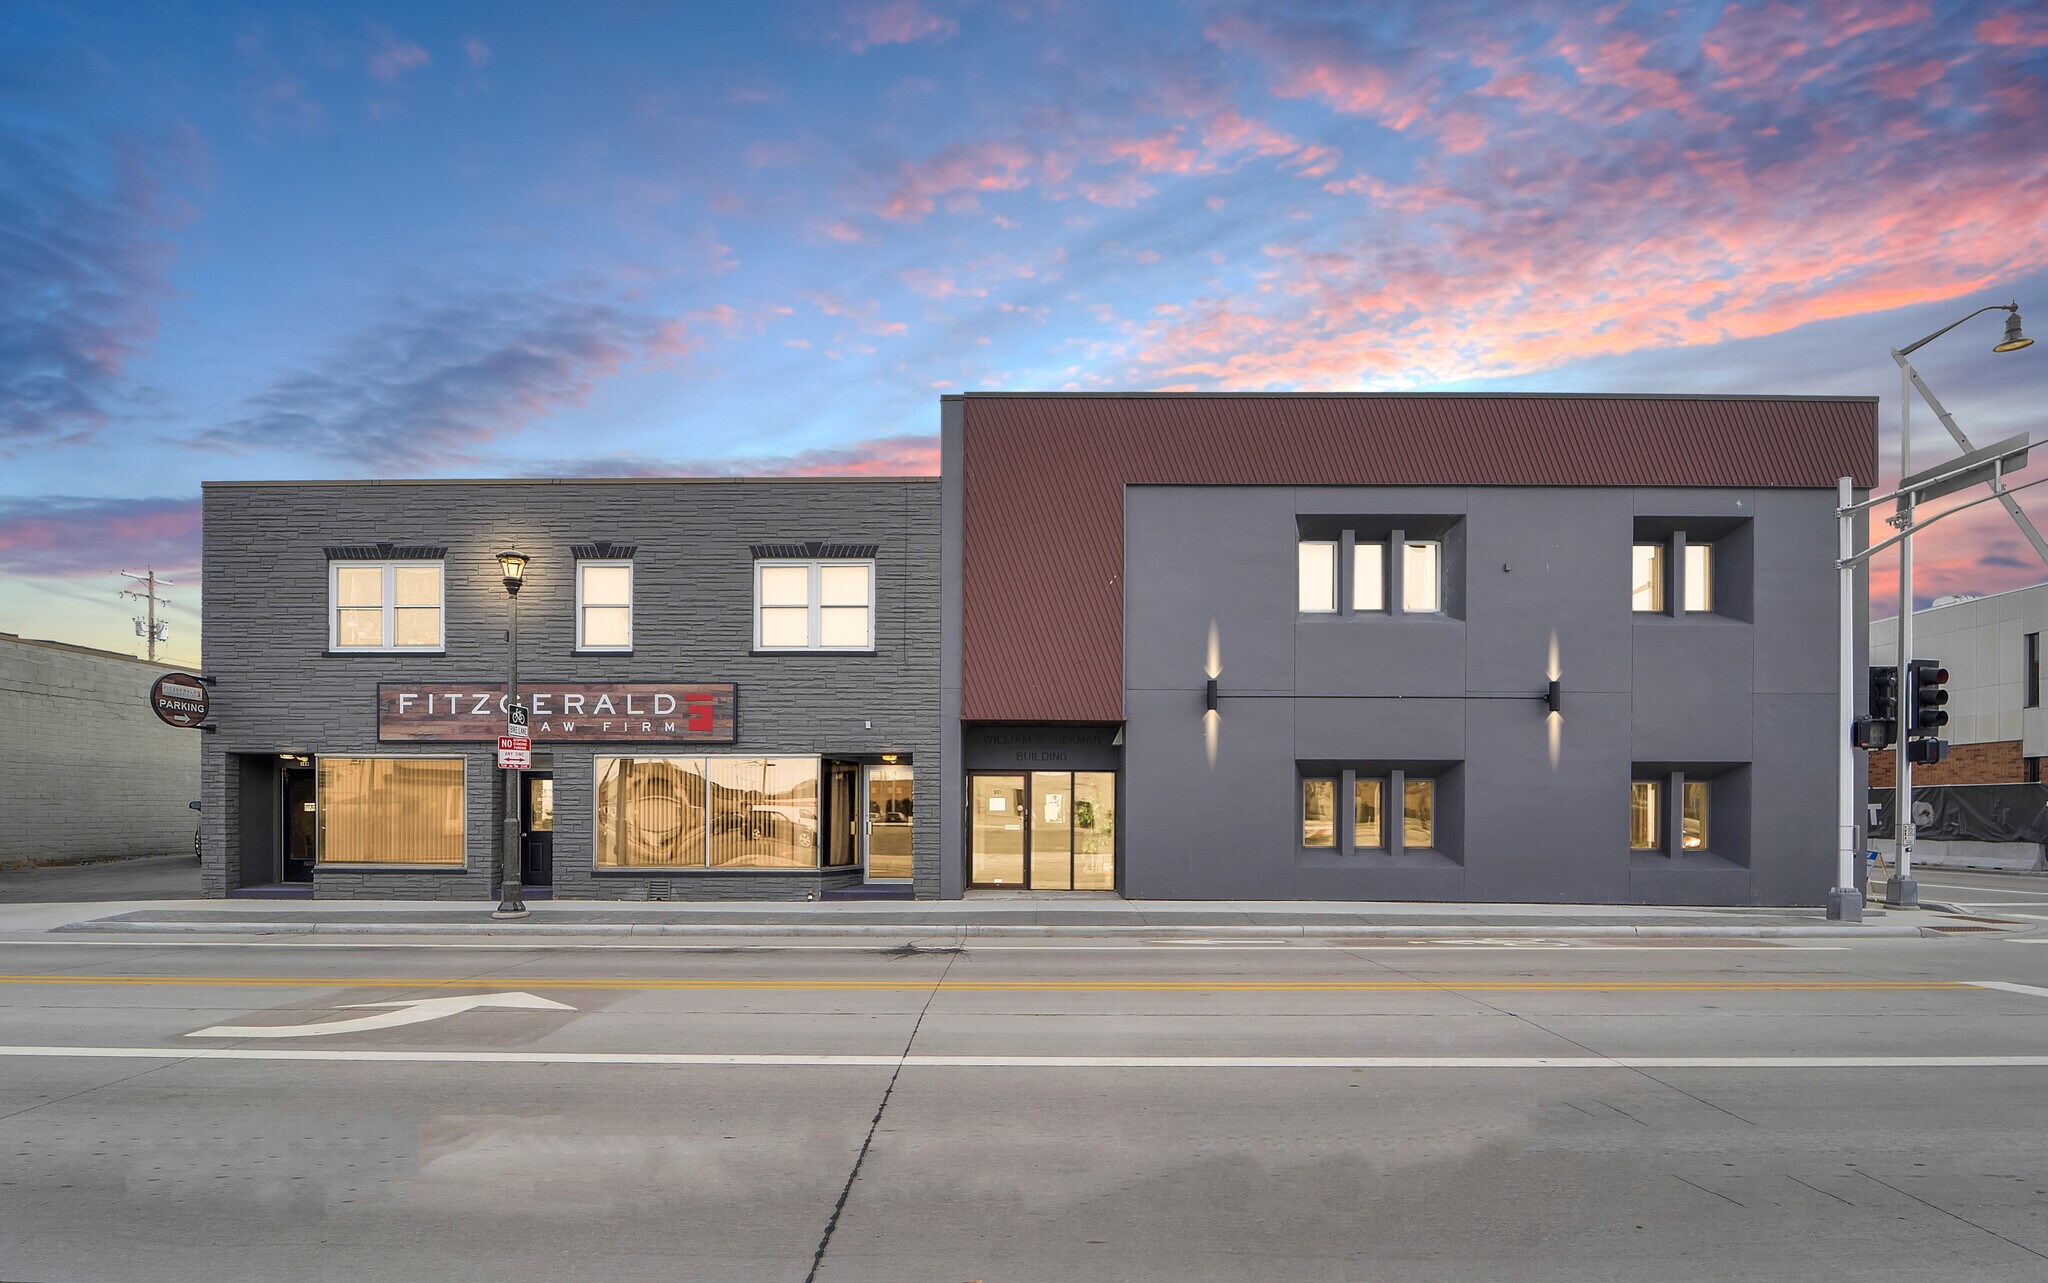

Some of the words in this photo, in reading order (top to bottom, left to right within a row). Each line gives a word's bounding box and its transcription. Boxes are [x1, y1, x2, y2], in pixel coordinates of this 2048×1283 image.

[159, 699, 204, 713] PARKING
[518, 727, 528, 735] LANE
[541, 722, 576, 732] AW
[603, 722, 676, 732] FIRM
[501, 739, 512, 748] NO
[983, 735, 1031, 745] WILLIAM
[1016, 751, 1068, 761] BUILDING
